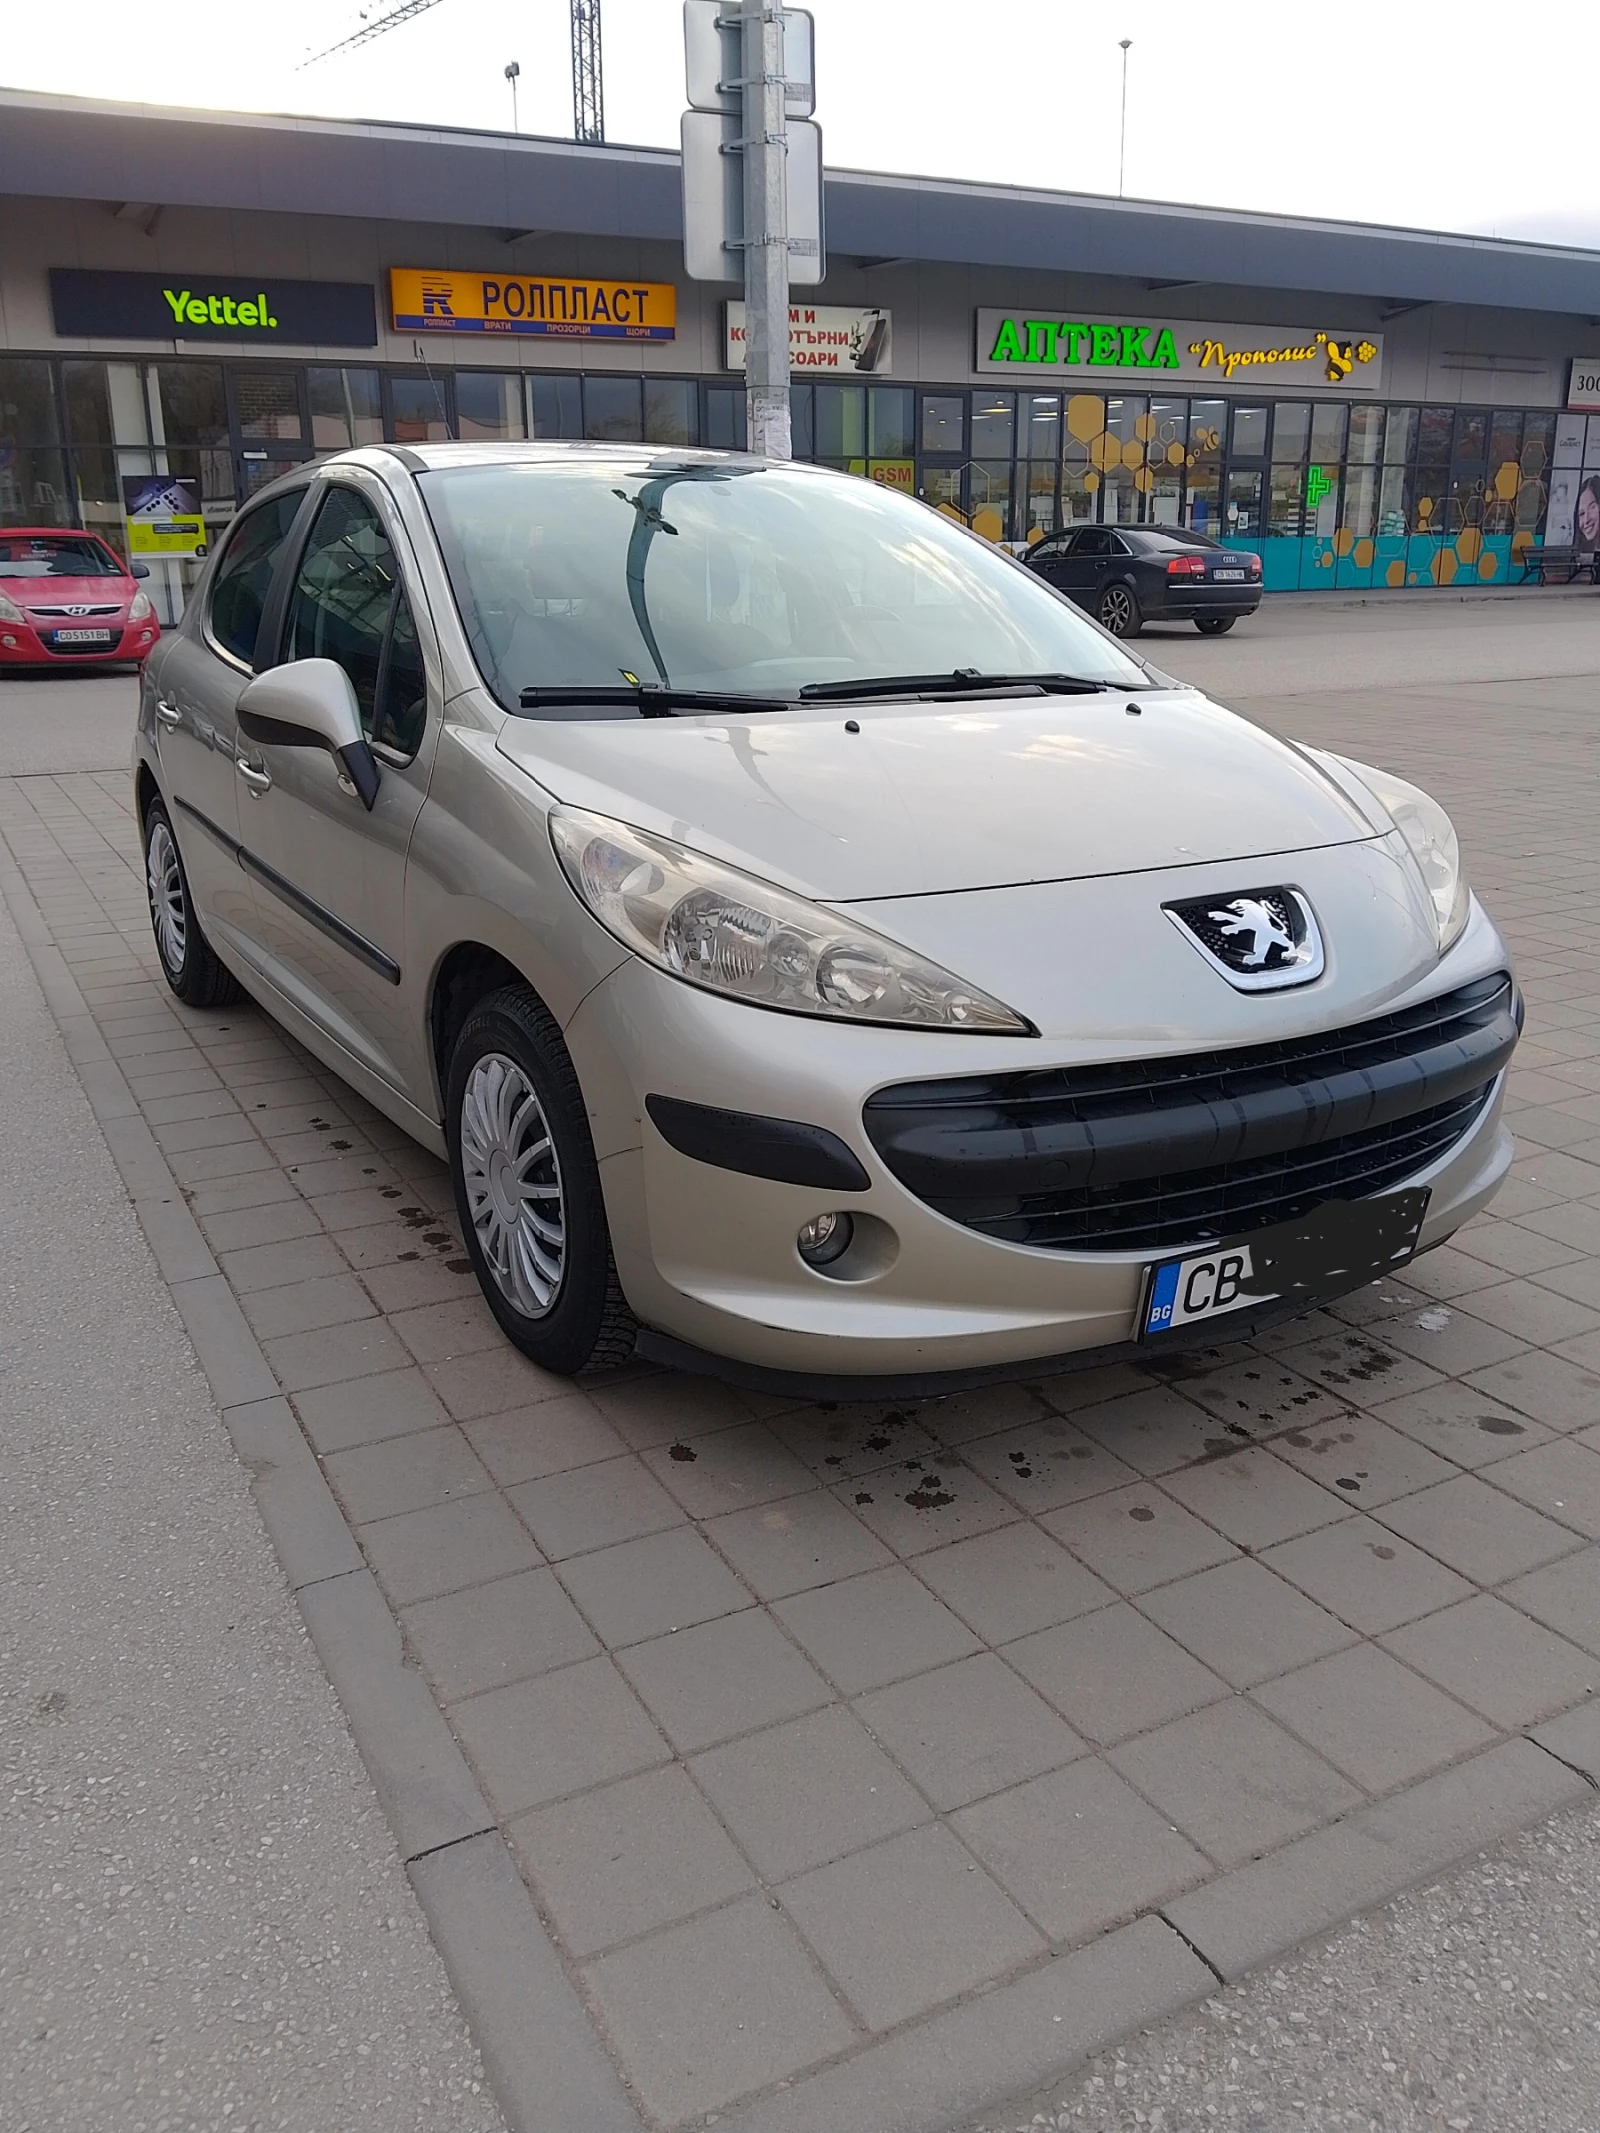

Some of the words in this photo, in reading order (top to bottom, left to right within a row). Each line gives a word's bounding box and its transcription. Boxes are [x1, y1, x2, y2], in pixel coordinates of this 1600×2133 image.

[162, 290, 278, 328] Yettel.
[482, 281, 649, 323] РОЛПЛАСТ
[484, 321, 512, 331] ВРАТИ
[546, 323, 591, 335] ПРОЗОРЦИ
[626, 327, 651, 337] ЩОРИ
[989, 319, 1180, 368] АПТЕКА
[872, 467, 911, 482] GSM
[1151, 1304, 1172, 1323] BG
[1183, 1255, 1244, 1314] CB
